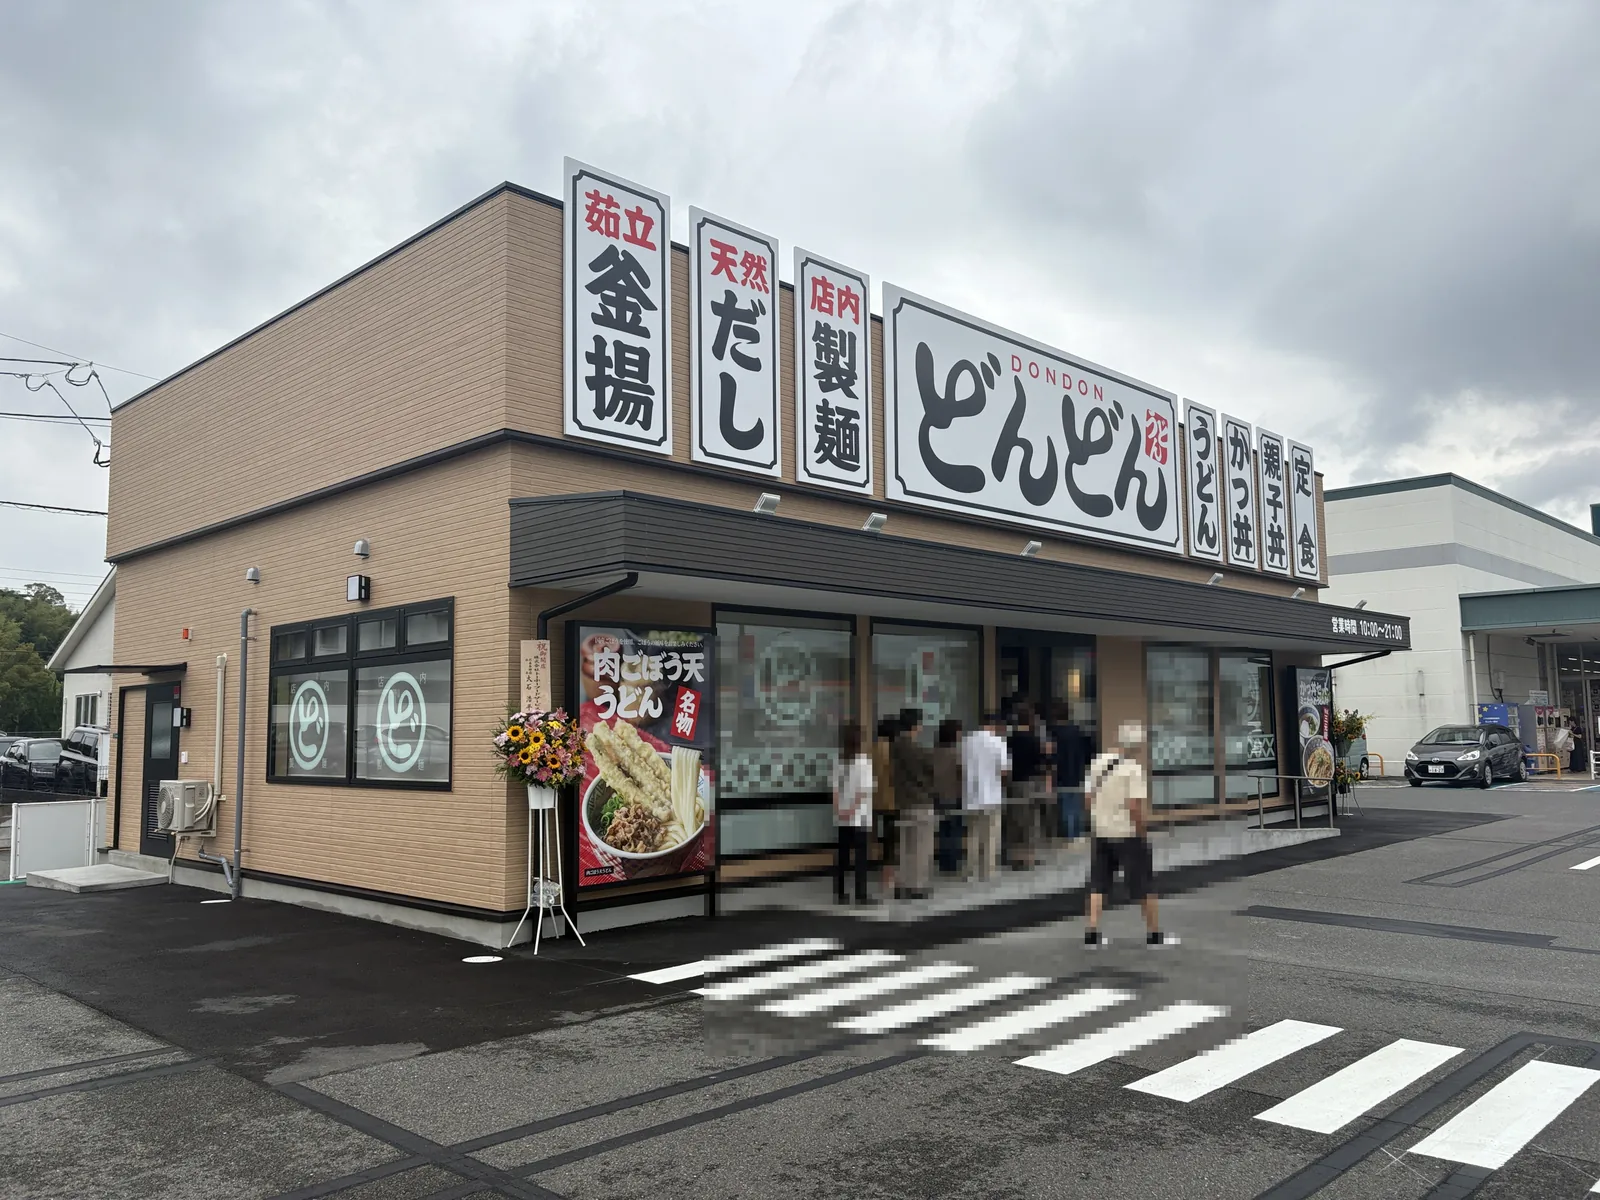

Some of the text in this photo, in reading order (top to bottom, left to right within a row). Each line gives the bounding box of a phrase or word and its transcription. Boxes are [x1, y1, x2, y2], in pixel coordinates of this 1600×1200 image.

[585, 189, 656, 251] 茹立
[709, 238, 769, 294] 天然
[810, 276, 860, 325] 店内
[585, 244, 658, 431] 釜揚
[711, 289, 766, 450] だし
[1011, 354, 1103, 402] DONDON
[812, 320, 861, 472] 製麺
[915, 341, 1168, 532] どんどん
[1193, 415, 1217, 549] うどん
[1229, 426, 1252, 559] かつ丼
[1263, 440, 1286, 567] 親子丼
[1294, 455, 1316, 569] 定食
[593, 646, 705, 683] 肉ごぼう天
[1331, 616, 1357, 635] 営業時間
[594, 685, 663, 719] うどん
[675, 690, 696, 737] 名物
